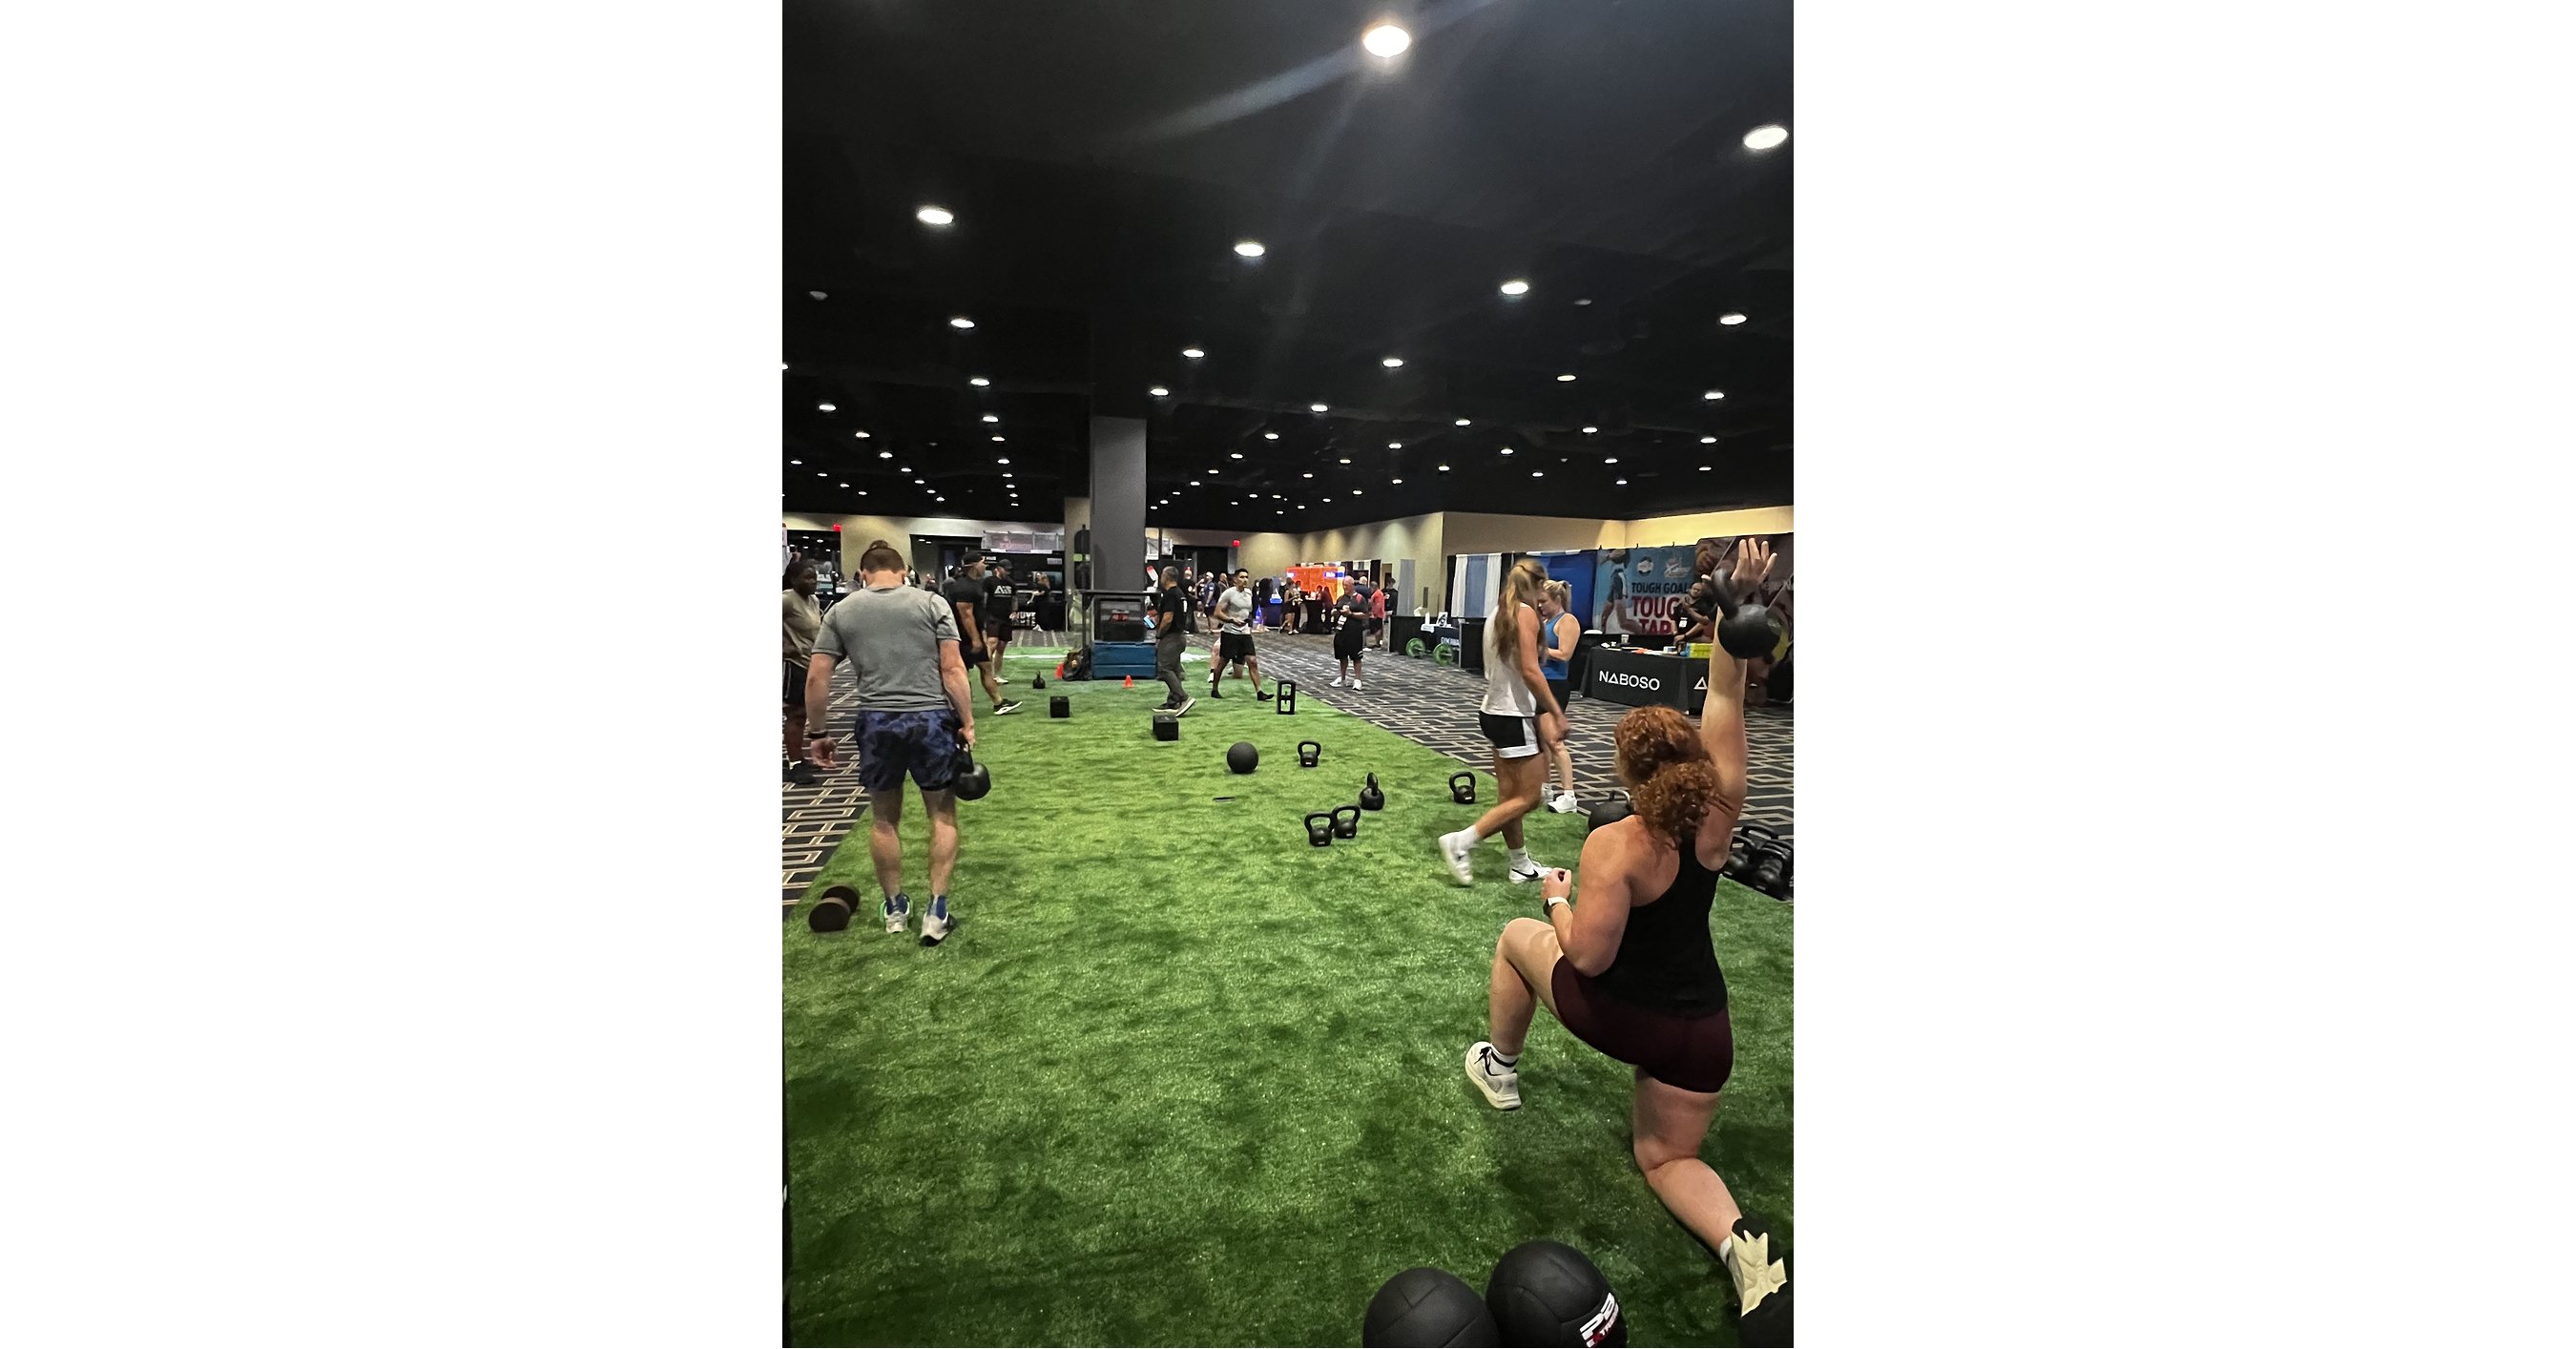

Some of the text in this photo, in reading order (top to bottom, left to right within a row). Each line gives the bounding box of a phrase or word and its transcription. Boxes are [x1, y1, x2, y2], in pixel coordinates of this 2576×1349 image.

[1631, 582, 1693, 594] TOUGH GOAL
[1631, 596, 1680, 620] TOUG
[1639, 619, 1672, 635] TAP
[1599, 671, 1660, 691] NABOSO
